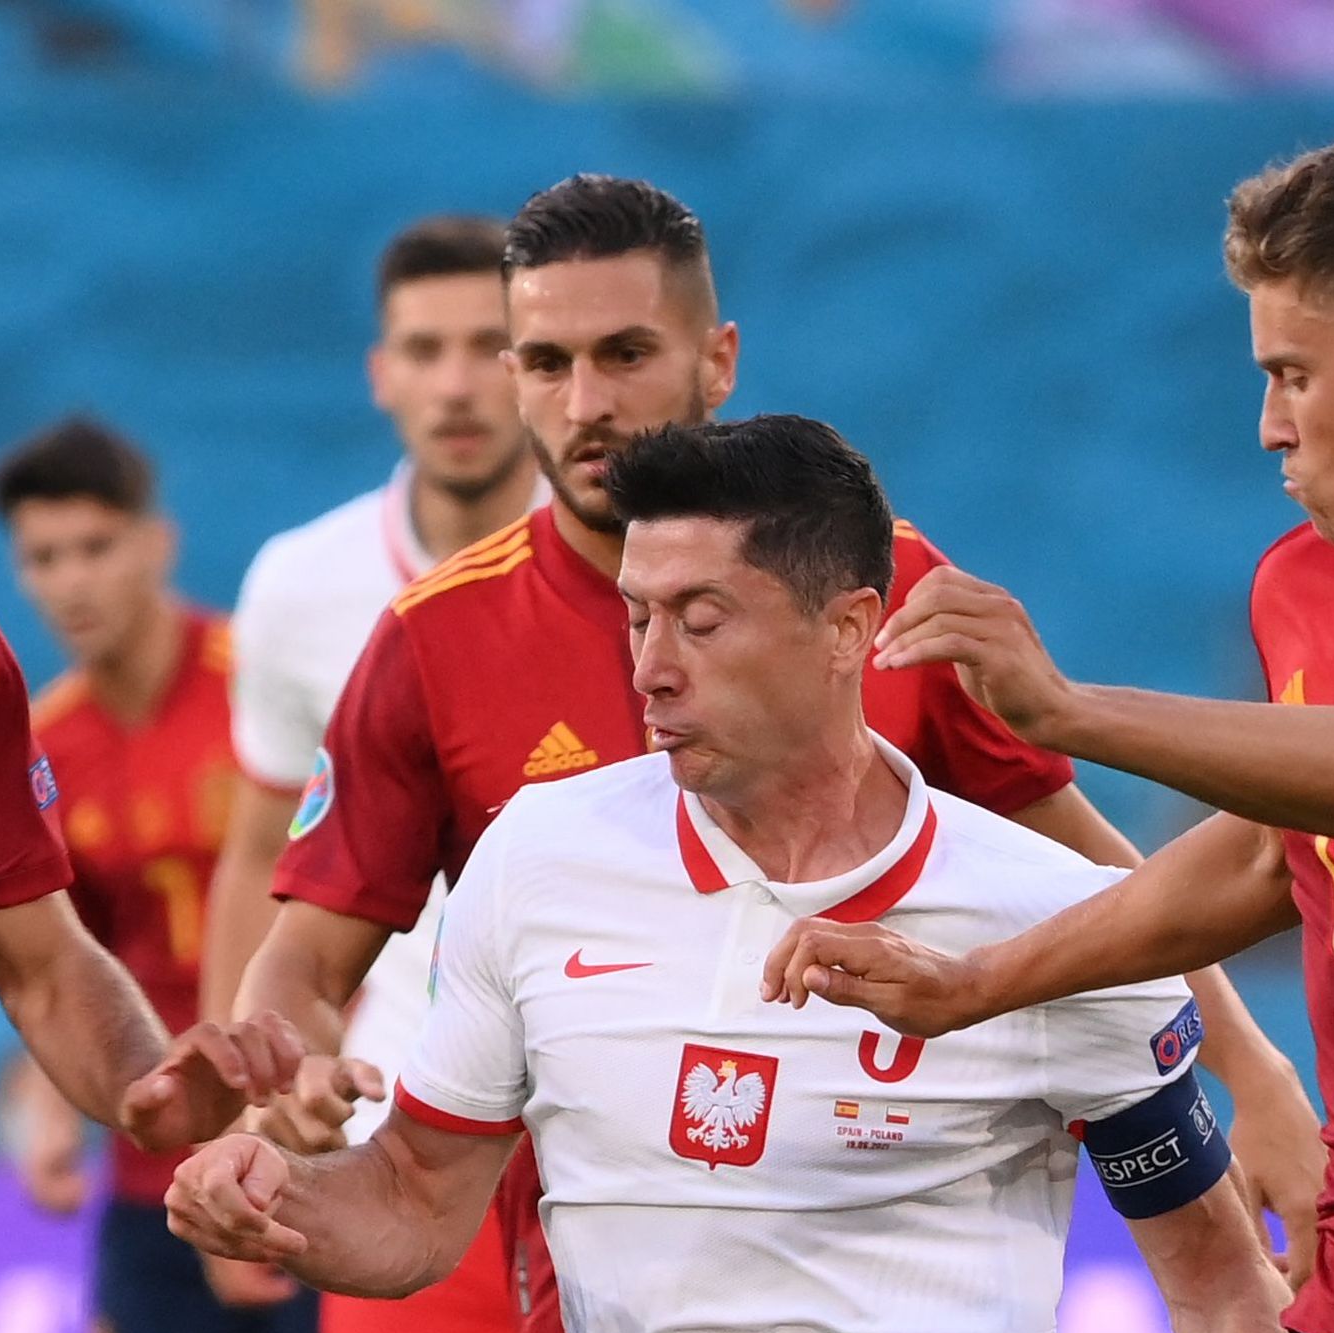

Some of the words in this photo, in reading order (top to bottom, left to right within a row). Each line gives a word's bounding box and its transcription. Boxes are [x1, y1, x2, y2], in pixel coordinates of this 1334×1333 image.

[523, 749, 598, 777] adidas
[836, 1126, 863, 1137] SPAIN
[870, 1129, 904, 1142] POLAND
[1095, 1135, 1183, 1182] ESPECT
